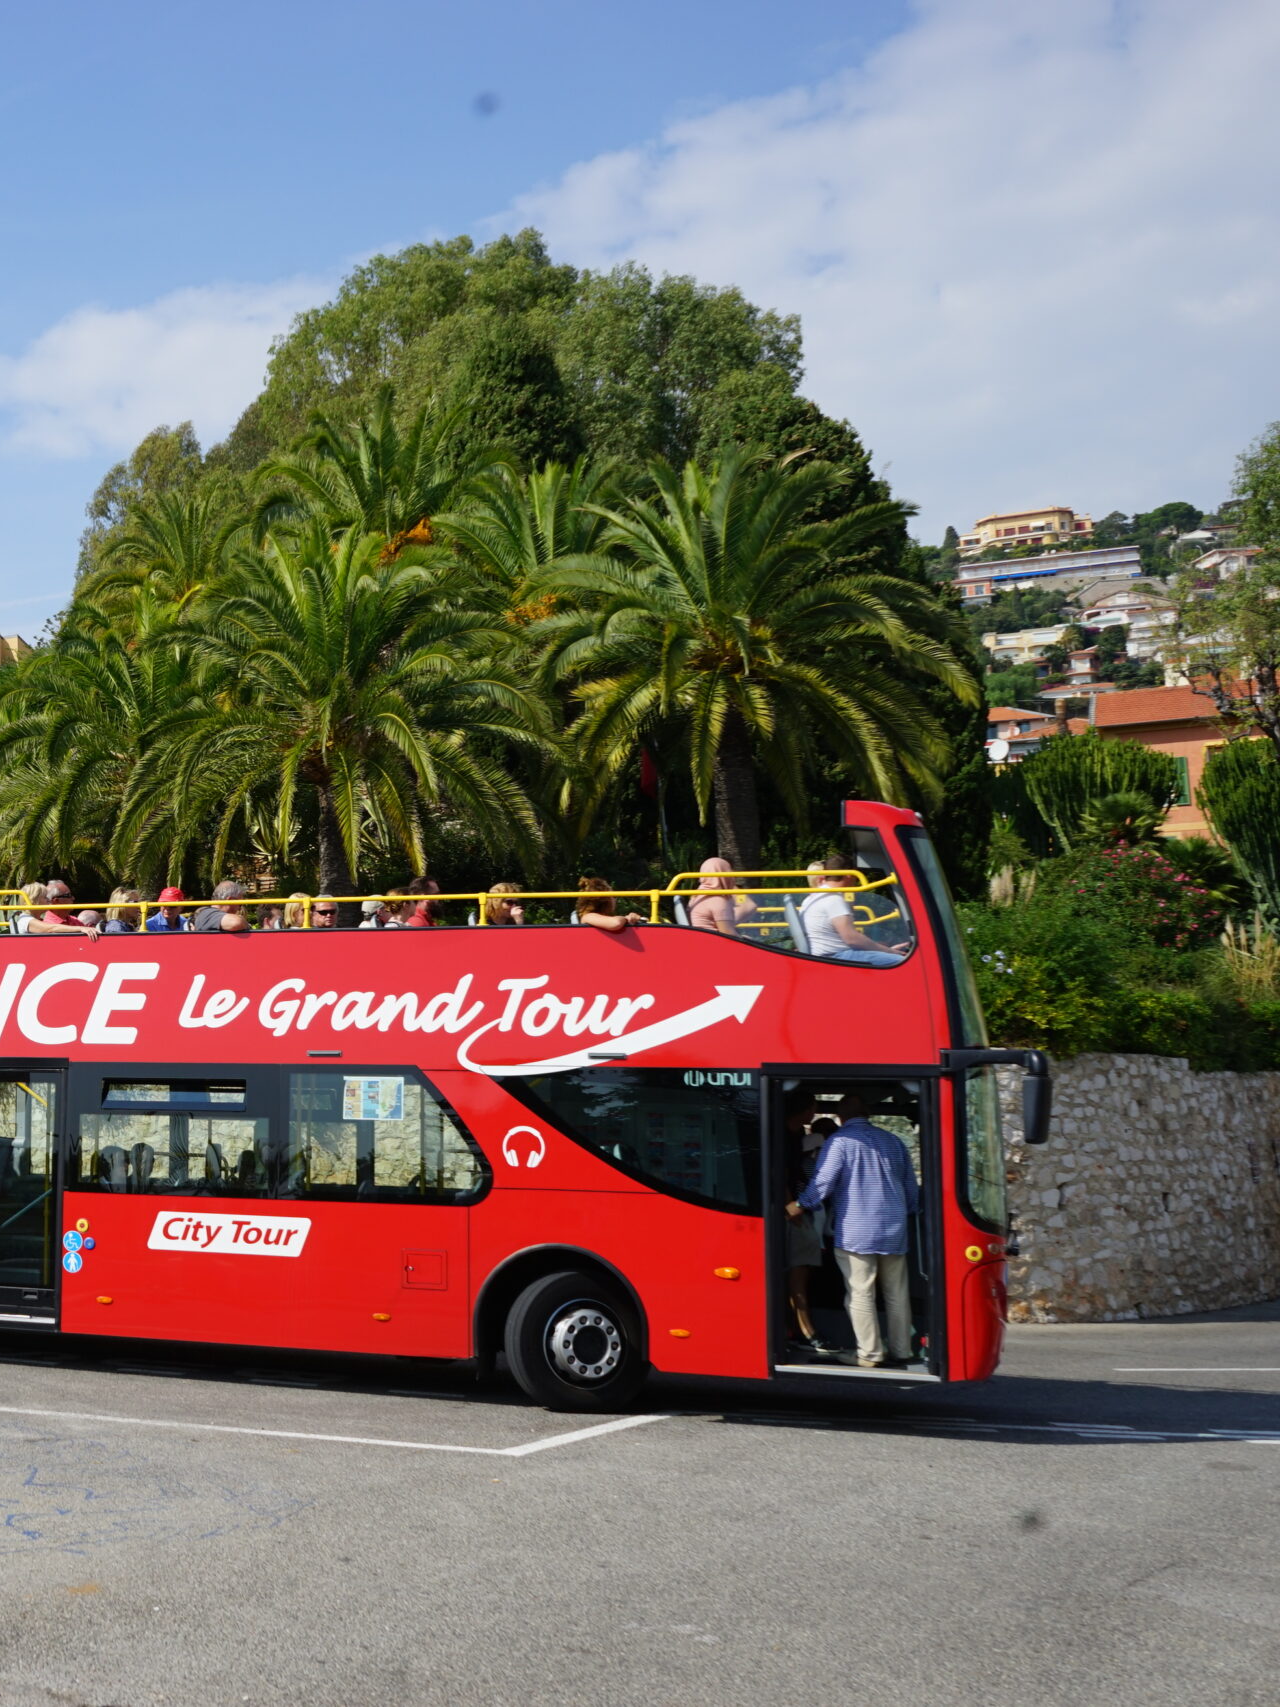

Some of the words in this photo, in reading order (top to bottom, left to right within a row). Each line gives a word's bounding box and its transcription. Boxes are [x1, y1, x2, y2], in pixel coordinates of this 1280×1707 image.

[258, 973, 485, 1037] Grand
[497, 974, 656, 1037] Tour
[162, 1217, 223, 1249] City
[231, 1220, 299, 1246] Tour
